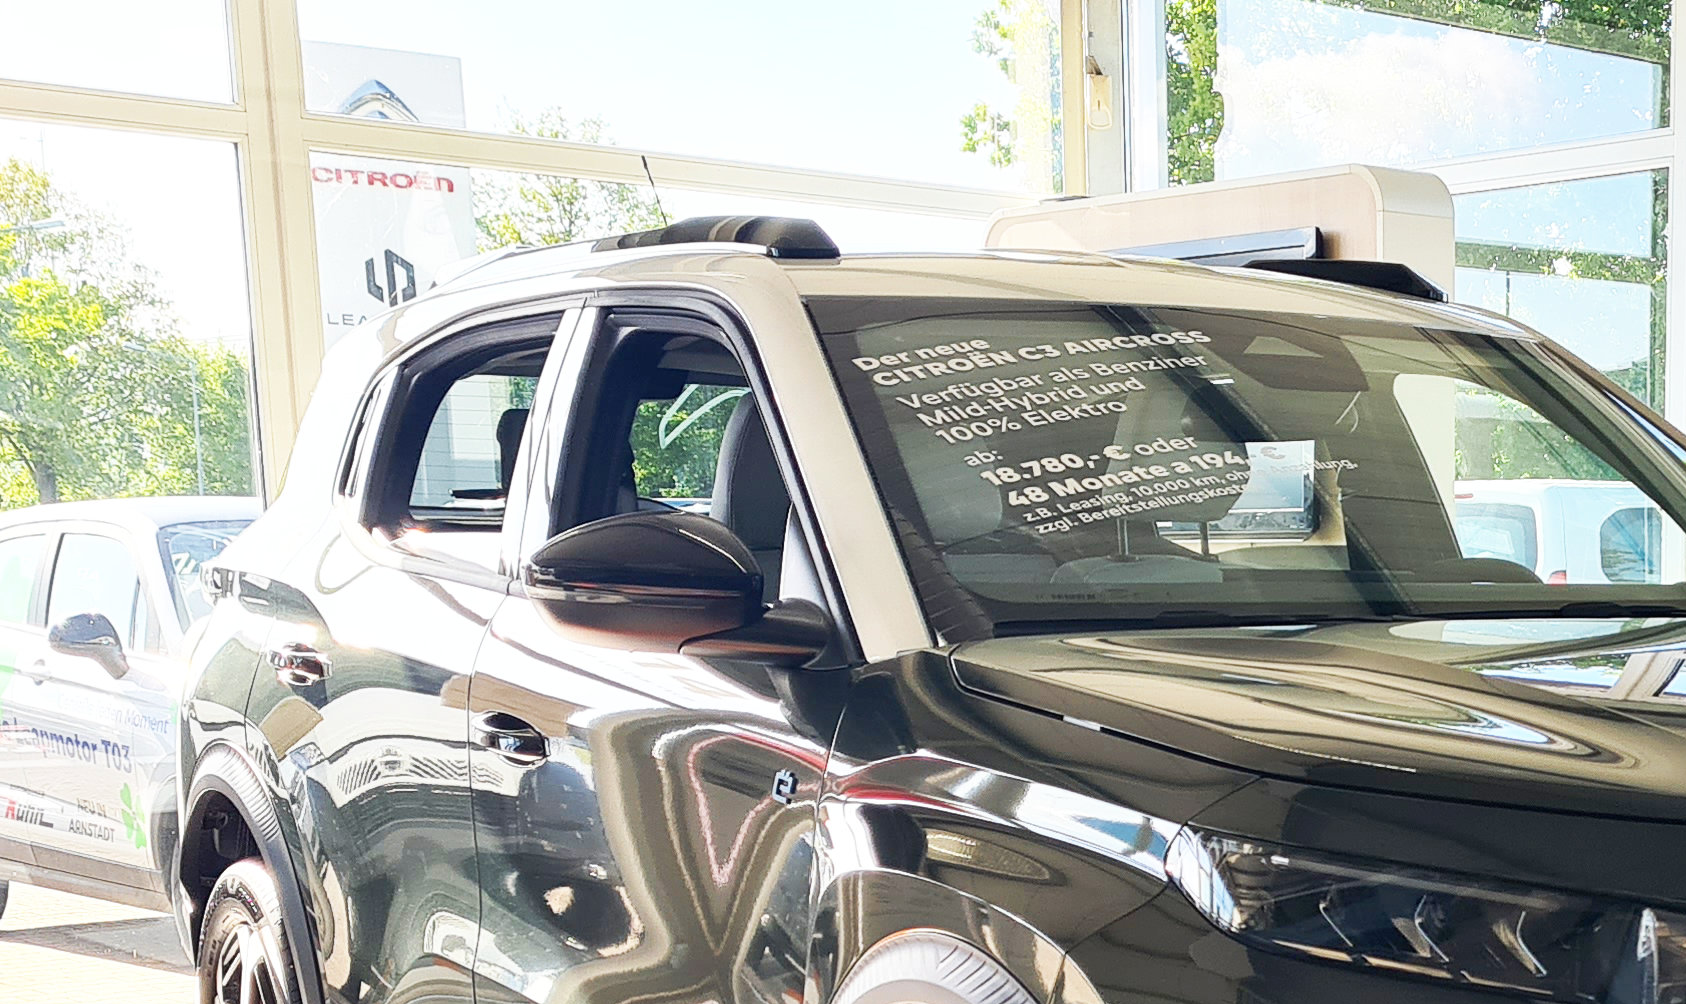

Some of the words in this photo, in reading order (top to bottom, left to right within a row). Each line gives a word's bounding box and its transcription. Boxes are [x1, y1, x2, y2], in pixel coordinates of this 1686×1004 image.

[327, 312, 368, 326] LEA
[851, 352, 911, 372] Der
[915, 339, 991, 359] neue
[872, 351, 1019, 386] CITROËN
[1018, 344, 1061, 361] C3
[1063, 330, 1212, 356] AIRCROSS
[895, 374, 1044, 410] Verfügbar
[1049, 366, 1091, 383] als
[1089, 353, 1208, 378] Benziner
[916, 384, 1088, 427] Mild-Hybrid
[1090, 376, 1147, 396] und
[935, 416, 1022, 445] 100%
[1021, 401, 1128, 428] Elektro
[964, 450, 1004, 467] ab:
[980, 453, 1100, 487] 18.780,-
[1102, 445, 1131, 462] €
[1134, 436, 1199, 456] oder
[1008, 486, 1050, 507] 48
[1048, 464, 1170, 498] Monate
[1171, 461, 1193, 475] a
[1023, 507, 1058, 523] z.B.
[1056, 492, 1133, 515] Leasing,
[1130, 475, 1190, 498] 10.000
[1193, 472, 1227, 488] km,
[1034, 516, 1079, 535] zzgl.
[1077, 484, 1248, 525] Bereitstellungskoste
[12, 716, 98, 765] Lapmotor
[100, 738, 133, 774] T03
[124, 707, 170, 735] Moment
[68, 817, 116, 844] ARNSTADT
